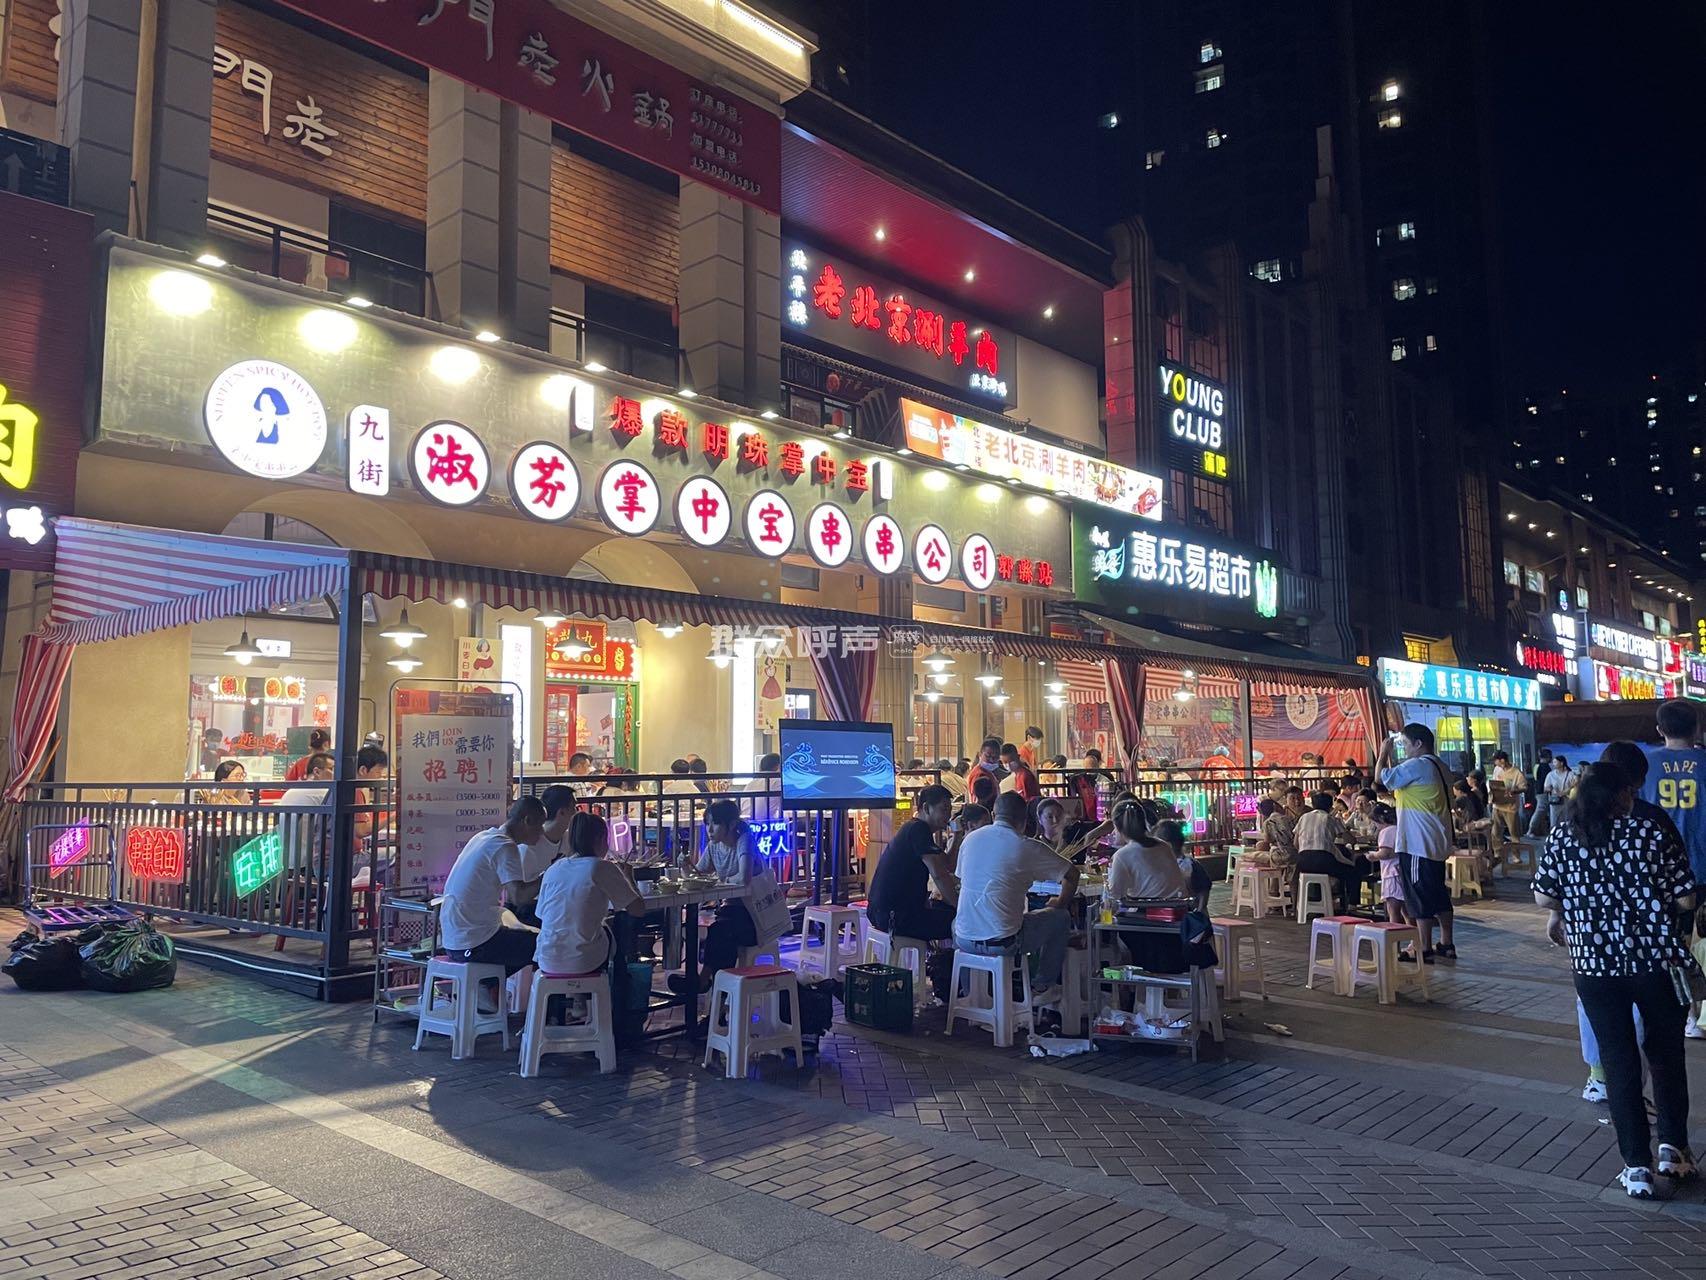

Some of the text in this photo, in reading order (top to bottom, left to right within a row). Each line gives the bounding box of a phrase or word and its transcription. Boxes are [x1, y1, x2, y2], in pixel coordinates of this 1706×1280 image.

[813, 263, 999, 377] 老北京涮羊肉
[1160, 365, 1223, 416] YOUNG
[609, 394, 869, 493] 爆款明珠掌中宝
[1172, 408, 1221, 448] CLUB
[358, 412, 385, 488] 九街
[984, 429, 1086, 486] 老北京涮羊肉
[426, 432, 988, 580] 淑芬掌中宝串串公司
[1131, 530, 1252, 599] 惠乐易超市
[412, 730, 440, 749] 我們
[442, 727, 463, 737] JOIN
[442, 737, 454, 746] US
[455, 735, 495, 754] 需要你
[1662, 760, 1697, 774] BAPE
[1658, 778, 1697, 809] 93
[612, 821, 629, 852] P
[770, 822, 786, 832] ren
[757, 835, 790, 856] 好人
